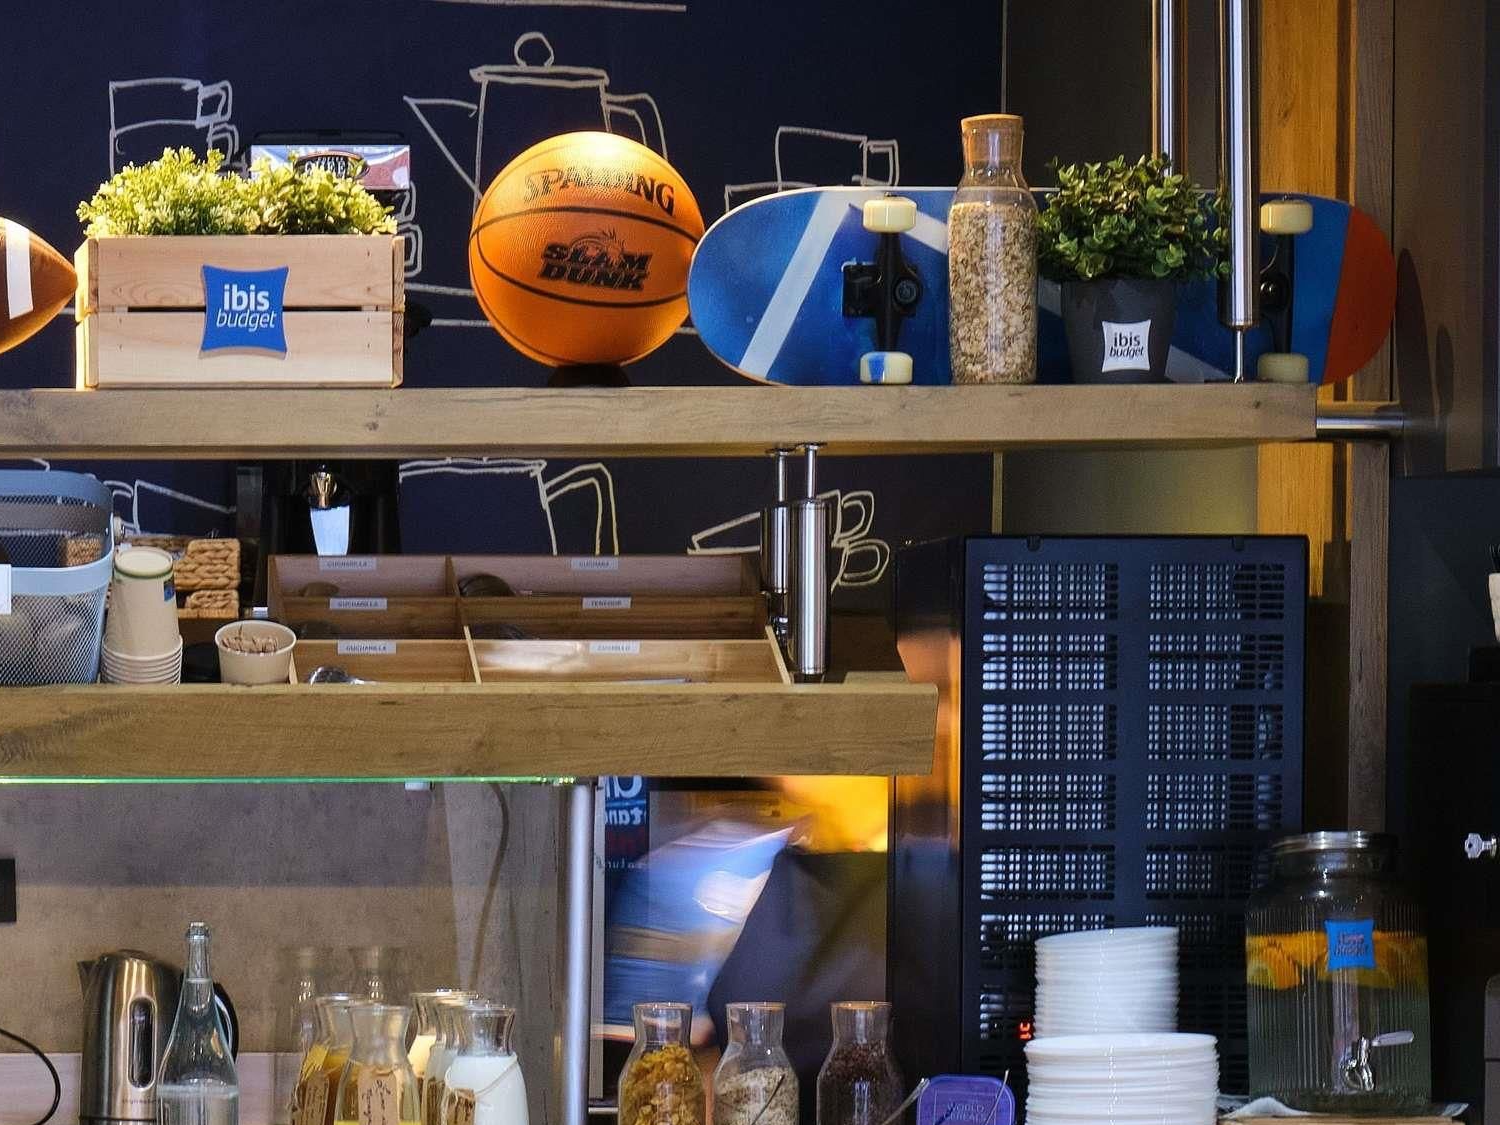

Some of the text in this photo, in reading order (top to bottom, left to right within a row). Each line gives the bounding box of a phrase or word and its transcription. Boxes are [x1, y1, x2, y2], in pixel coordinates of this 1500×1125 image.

[524, 165, 675, 216] SPALDING
[541, 242, 652, 271] SLAM
[537, 263, 647, 290] DUNK
[223, 283, 270, 311] ibis
[216, 308, 277, 332] budget
[1114, 331, 1141, 347] ibis
[1109, 345, 1144, 359] budget
[946, 1101, 985, 1113] WORLD
